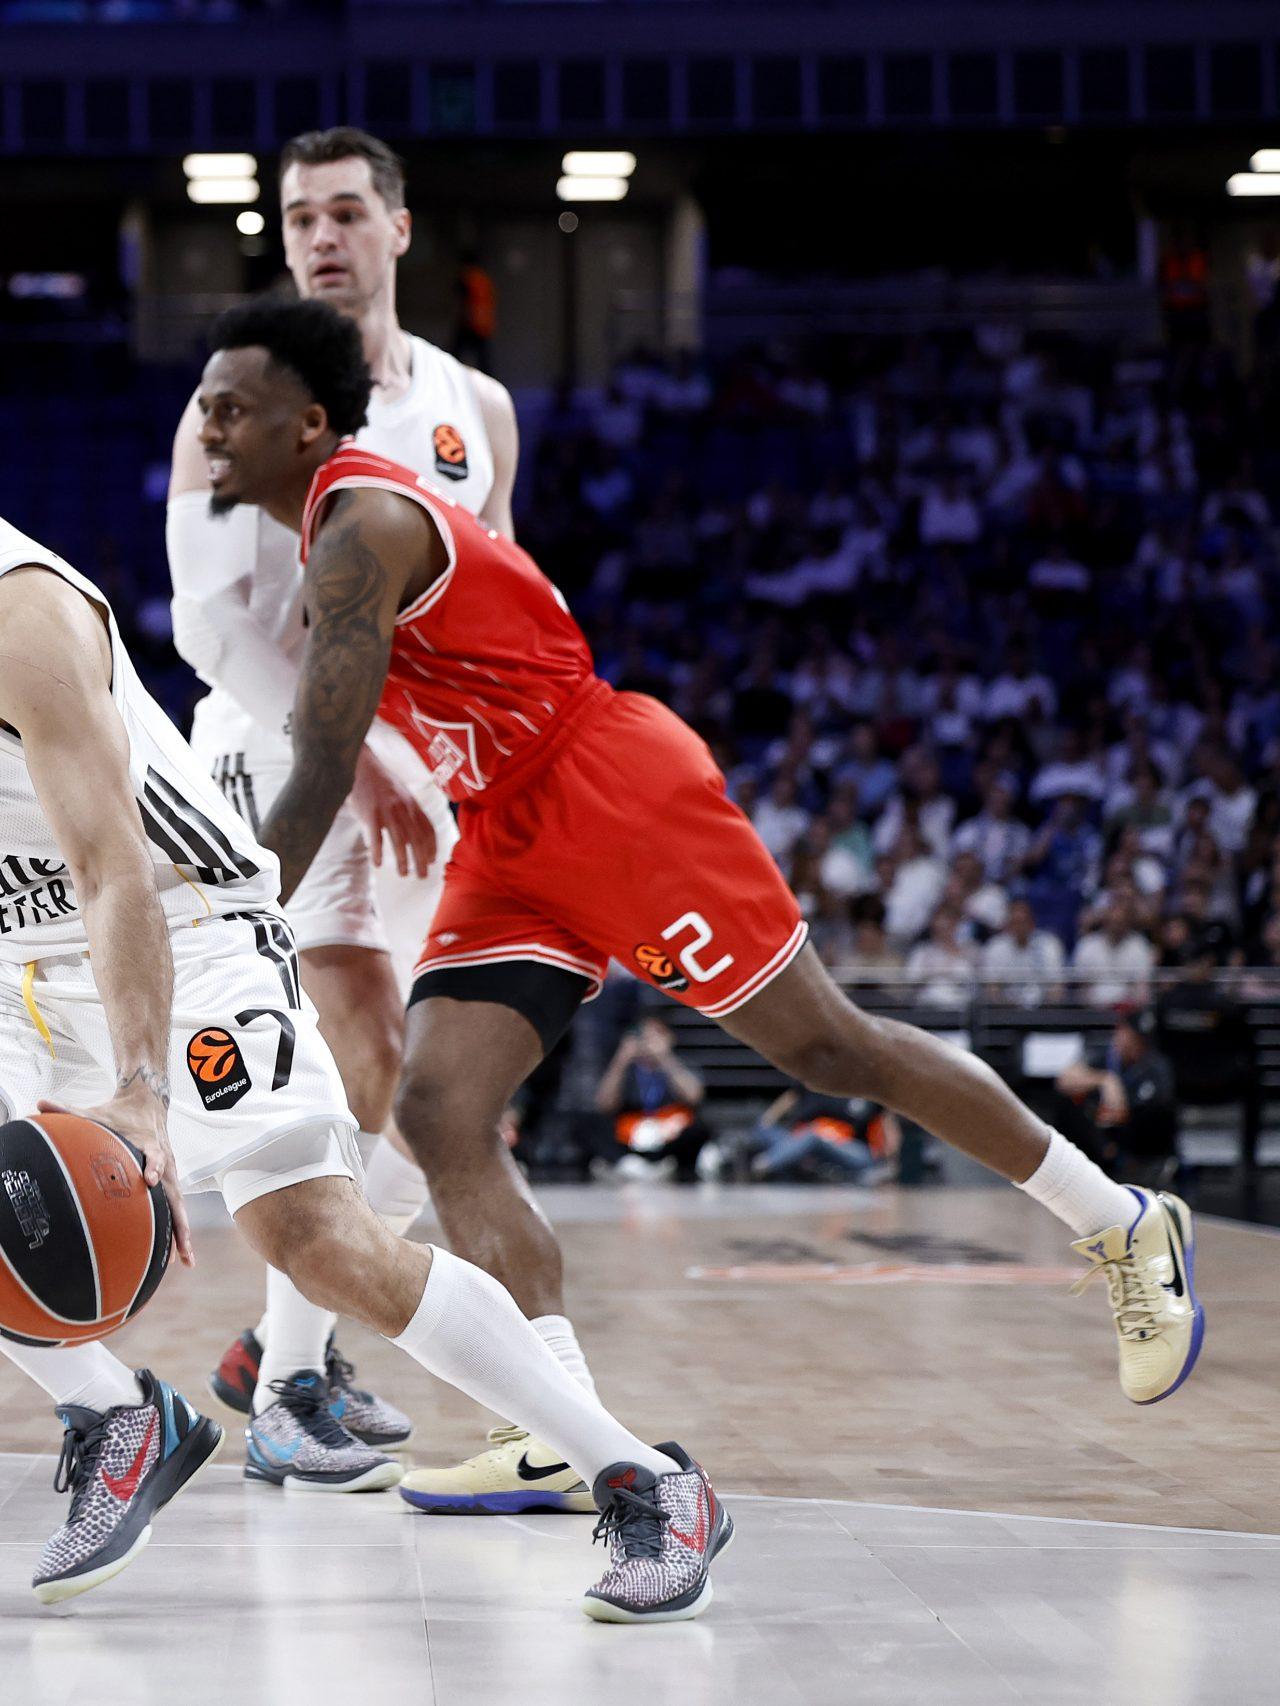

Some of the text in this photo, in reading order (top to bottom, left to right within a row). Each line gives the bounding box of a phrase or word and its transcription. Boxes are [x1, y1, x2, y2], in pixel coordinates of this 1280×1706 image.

[660, 911, 735, 983] 2
[234, 1008, 296, 1092] 7
[205, 1078, 247, 1104] EuroLeague
